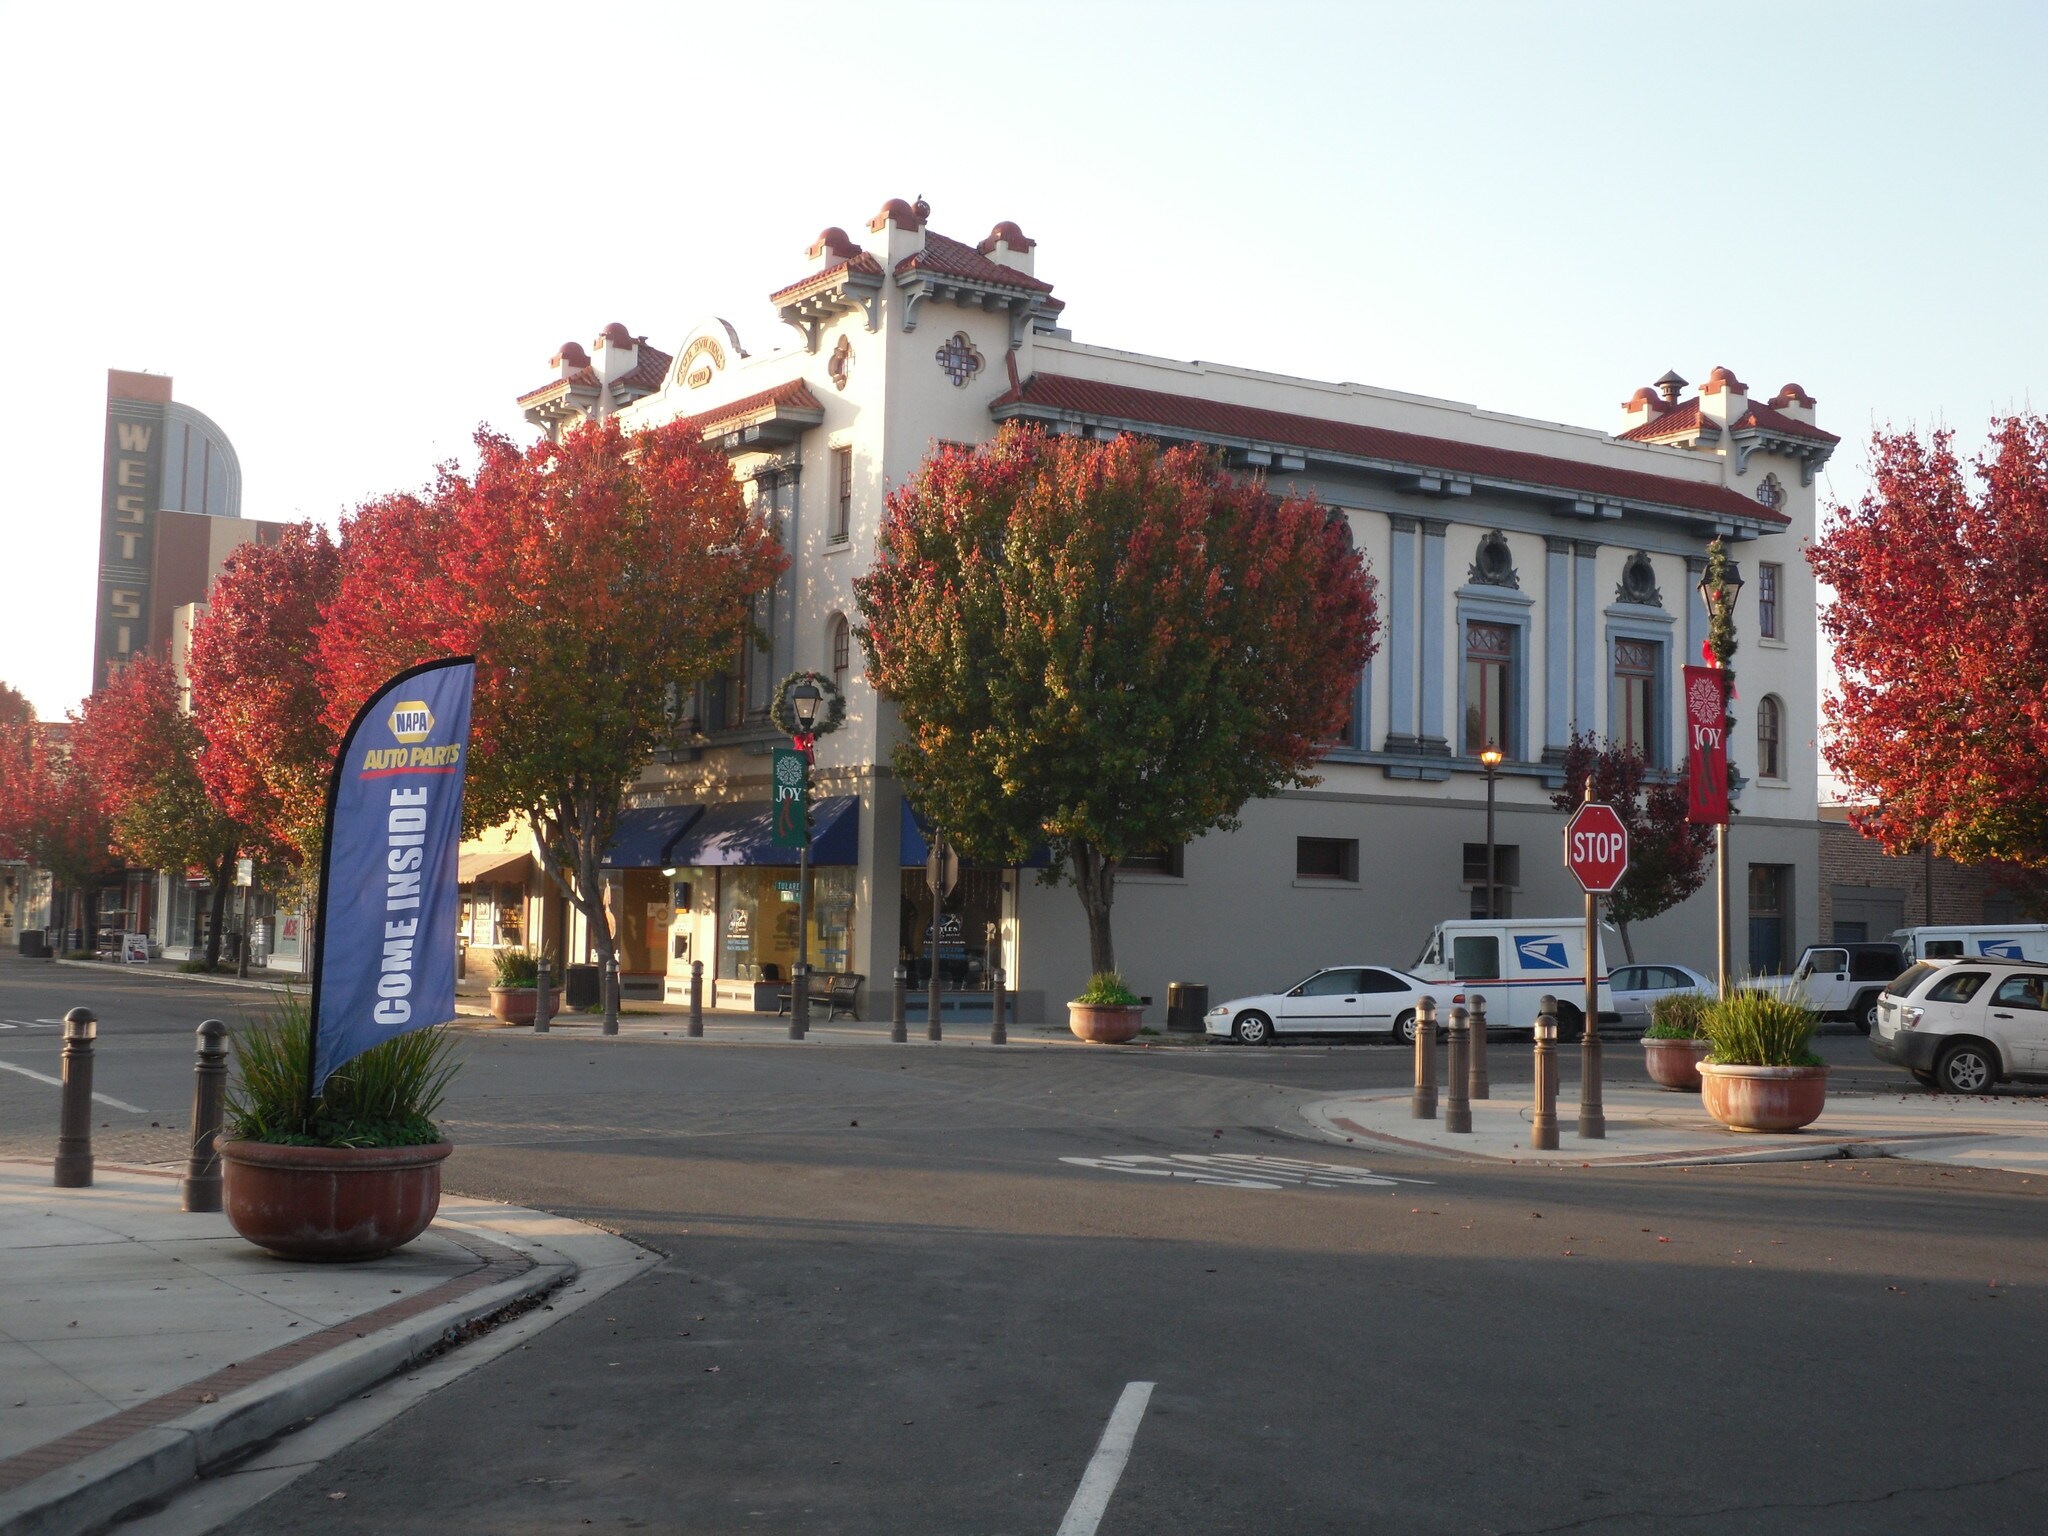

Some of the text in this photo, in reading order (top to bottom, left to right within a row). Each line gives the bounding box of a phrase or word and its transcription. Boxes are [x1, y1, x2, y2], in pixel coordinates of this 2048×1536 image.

[115, 422, 150, 560] WEST
[395, 712, 427, 733] NAPA
[1693, 724, 1722, 751] JOY
[362, 743, 460, 770] AUTO PARTS
[775, 785, 801, 802] JOY
[1573, 831, 1623, 863] STOP
[373, 786, 427, 1025] COME INSIDE
[283, 918, 297, 936] ACE
